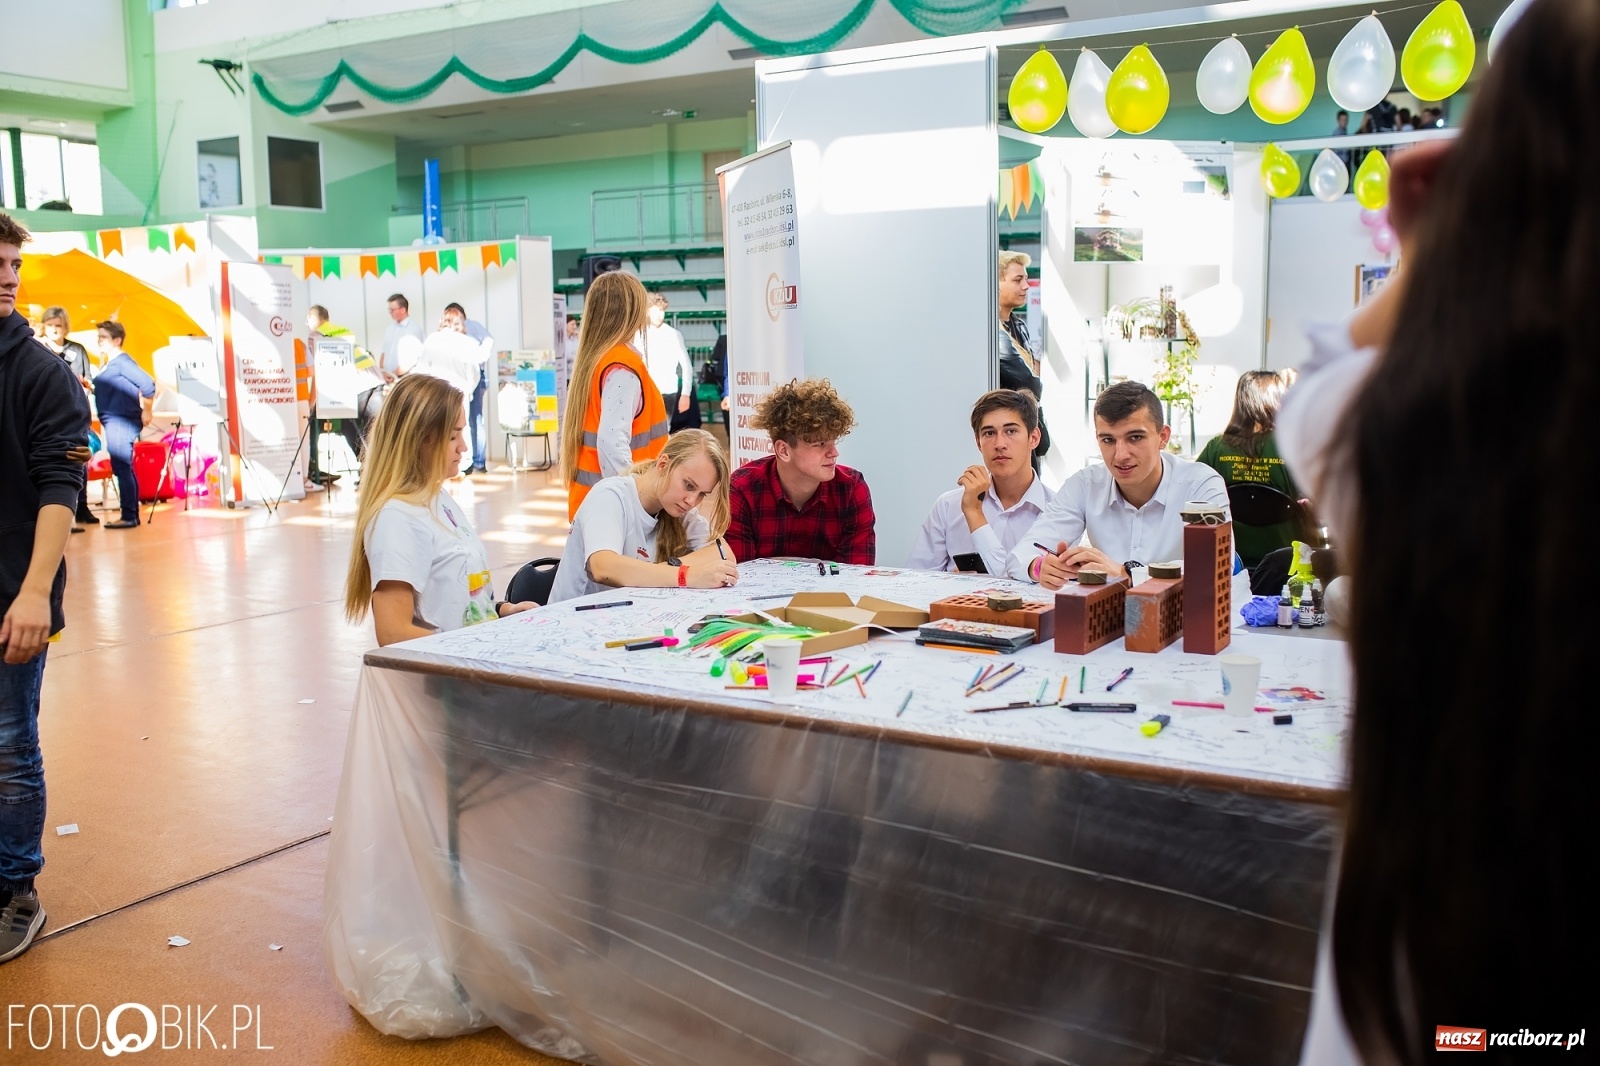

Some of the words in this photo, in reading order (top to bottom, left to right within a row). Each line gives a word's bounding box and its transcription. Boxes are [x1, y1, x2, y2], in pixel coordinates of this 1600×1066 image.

[782, 188, 792, 199] 6-8,
[785, 204, 794, 214] 63
[736, 371, 770, 386] CENTRUM
[742, 436, 776, 454] USTAWICZ
